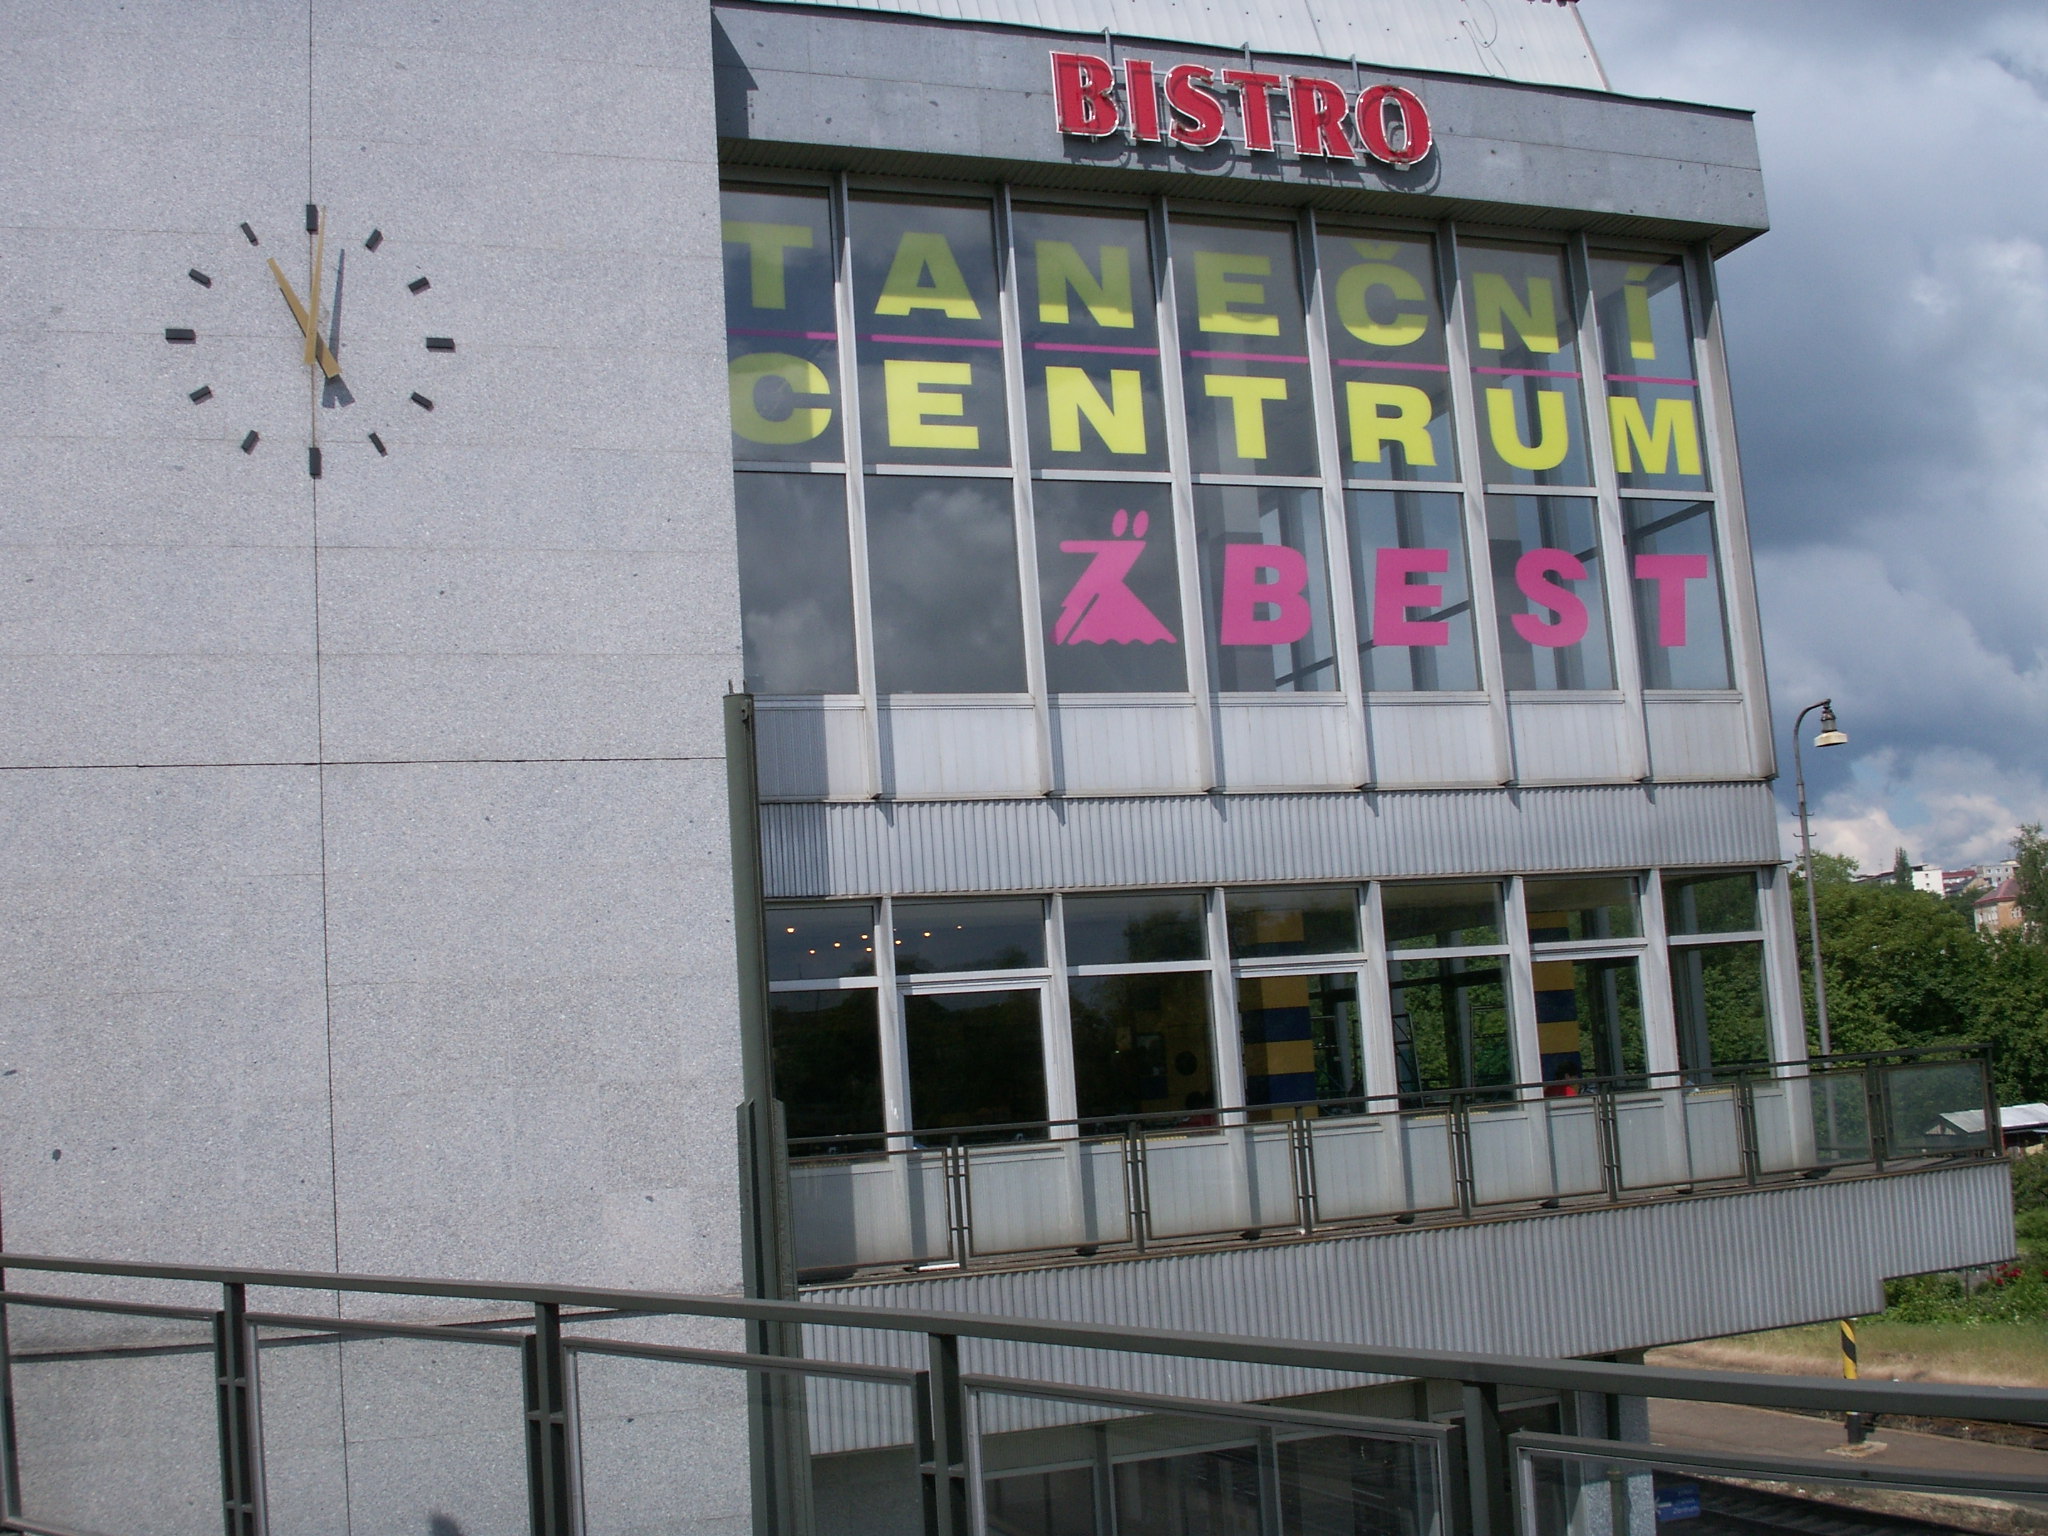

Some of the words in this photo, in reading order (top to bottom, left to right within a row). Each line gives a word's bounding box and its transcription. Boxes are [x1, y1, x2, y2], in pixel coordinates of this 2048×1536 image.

[1049, 50, 1433, 166] BISTRO
[721, 220, 1656, 360] TANEČNÍ
[728, 351, 1703, 476] CENTRUM
[1220, 543, 1709, 648] BEST
